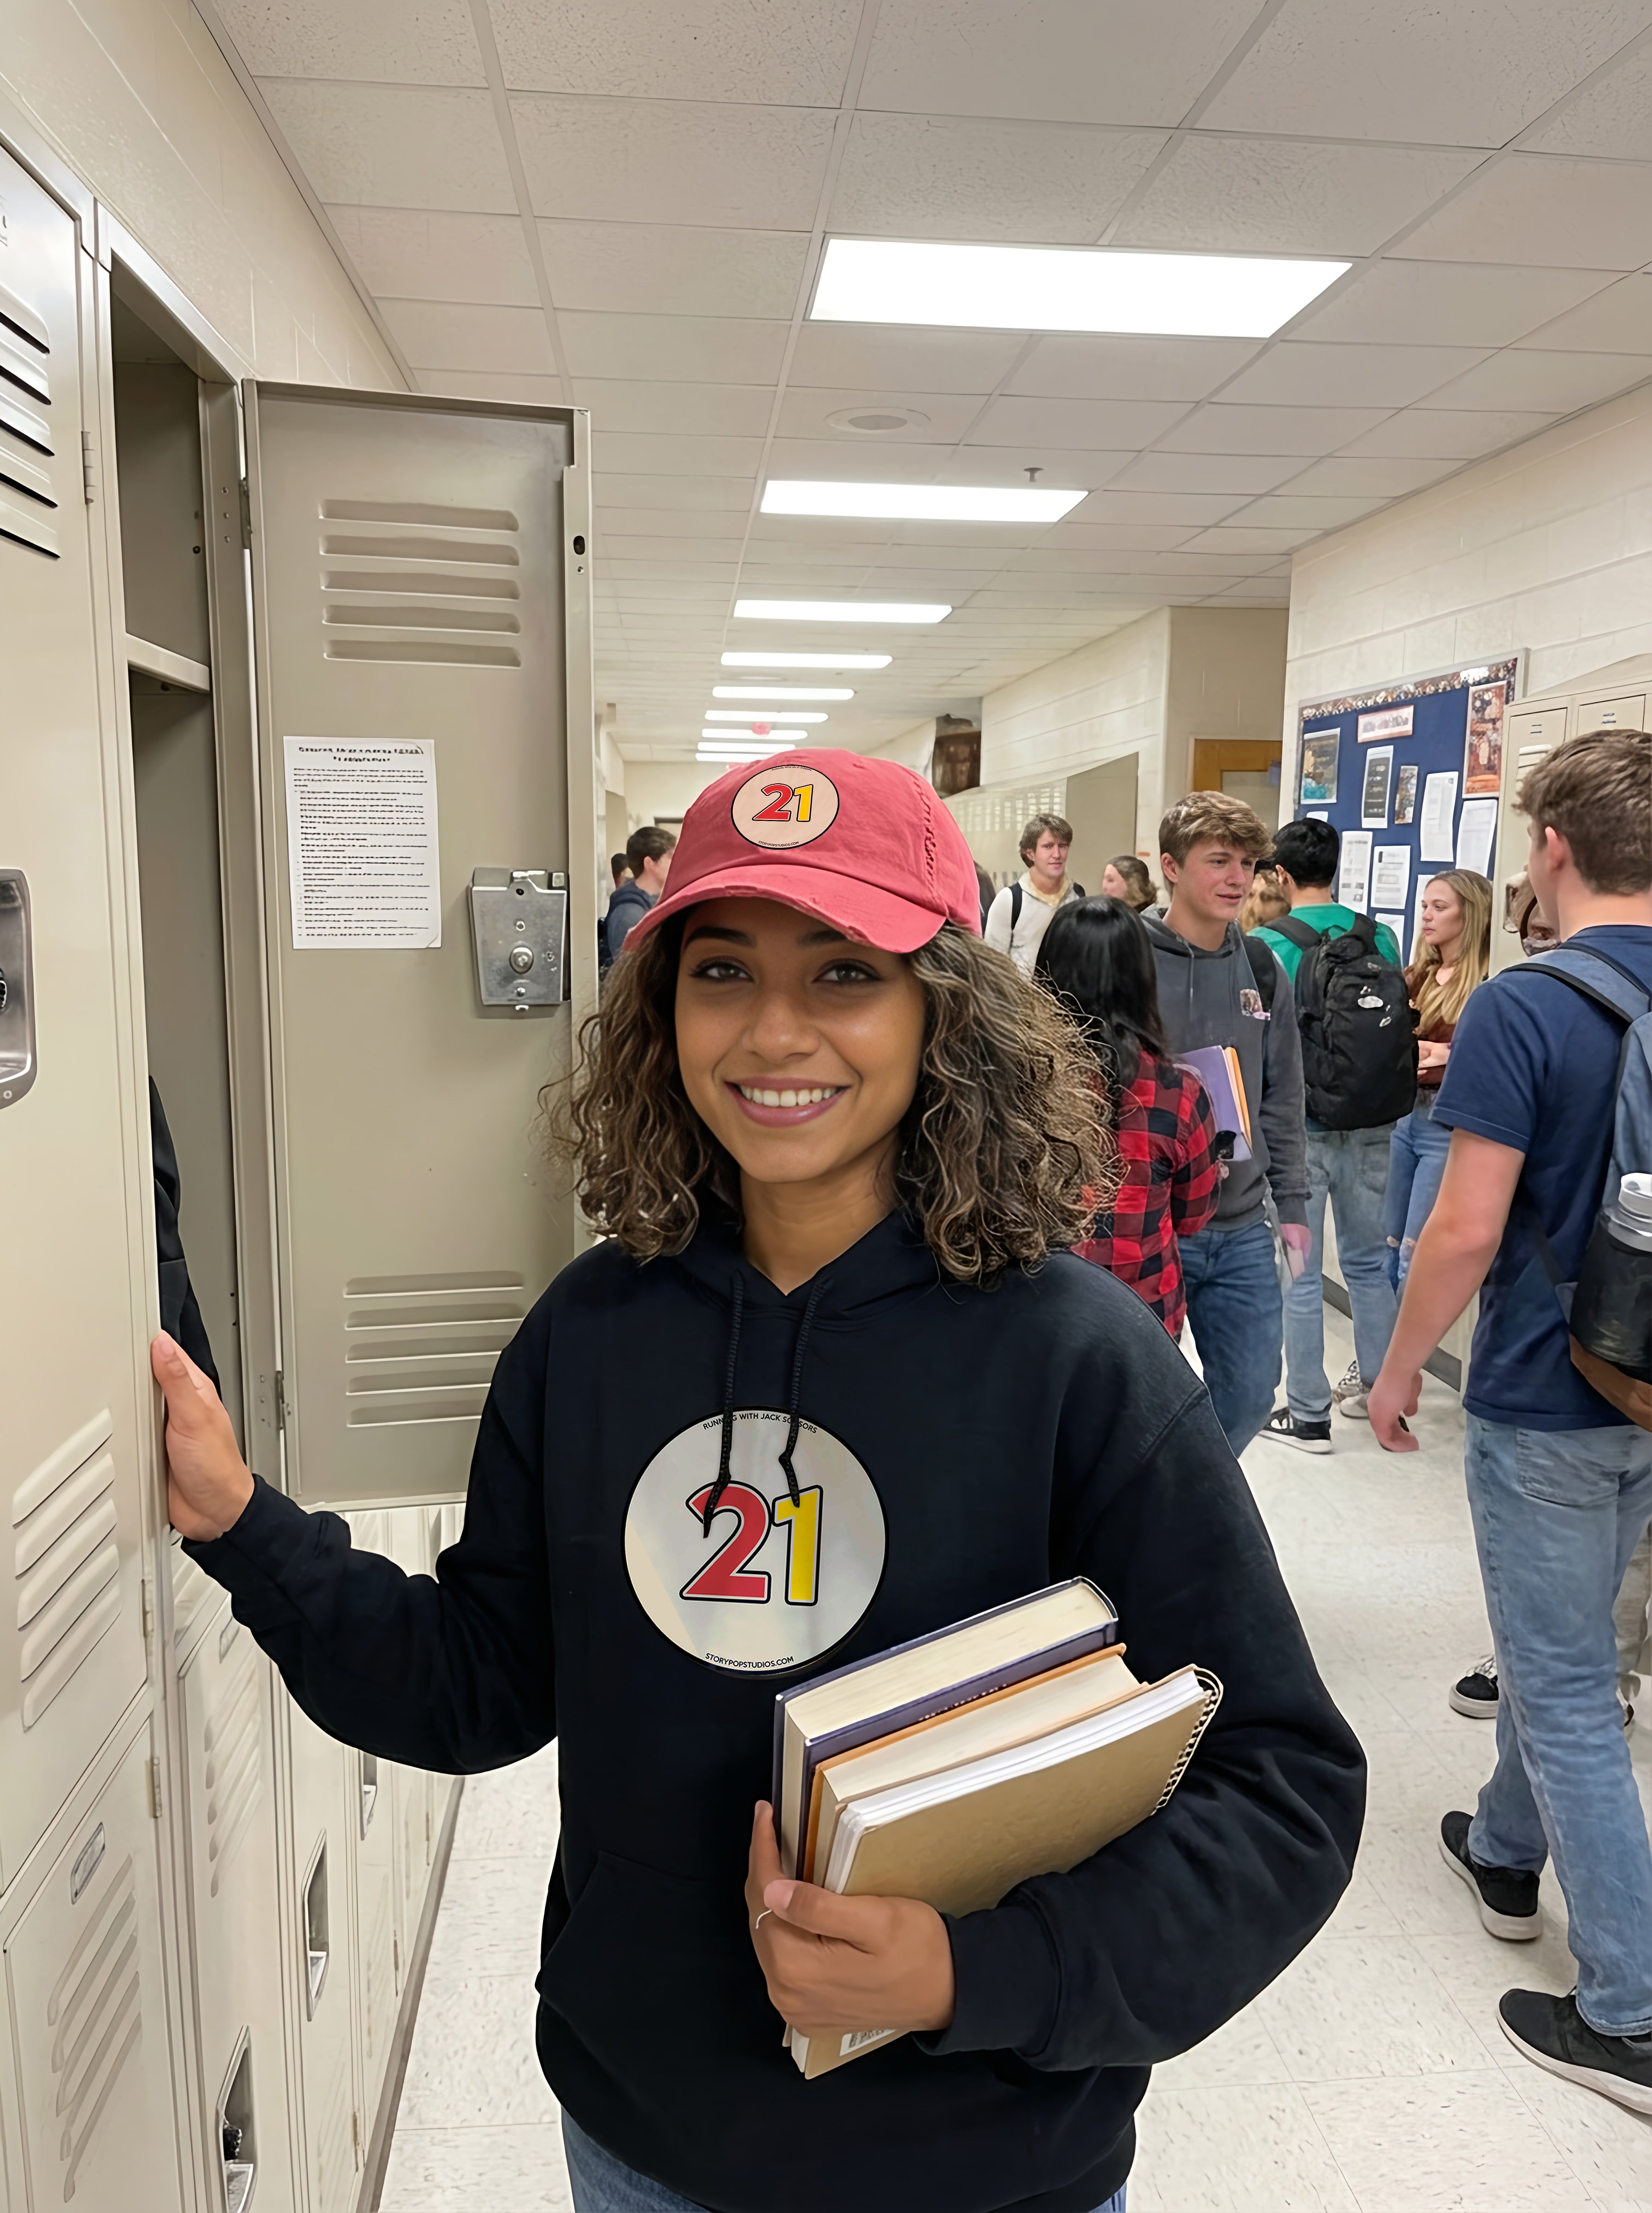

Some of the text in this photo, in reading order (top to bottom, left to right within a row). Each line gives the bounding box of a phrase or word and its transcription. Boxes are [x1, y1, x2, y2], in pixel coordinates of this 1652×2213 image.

[752, 783, 814, 822] 21
[703, 1415, 737, 1430] RUNNG
[782, 1416, 818, 1433] SCSORS
[679, 1480, 824, 1606] 21
[705, 1653, 794, 1668] STORYPOPSTUDIOS.COM
